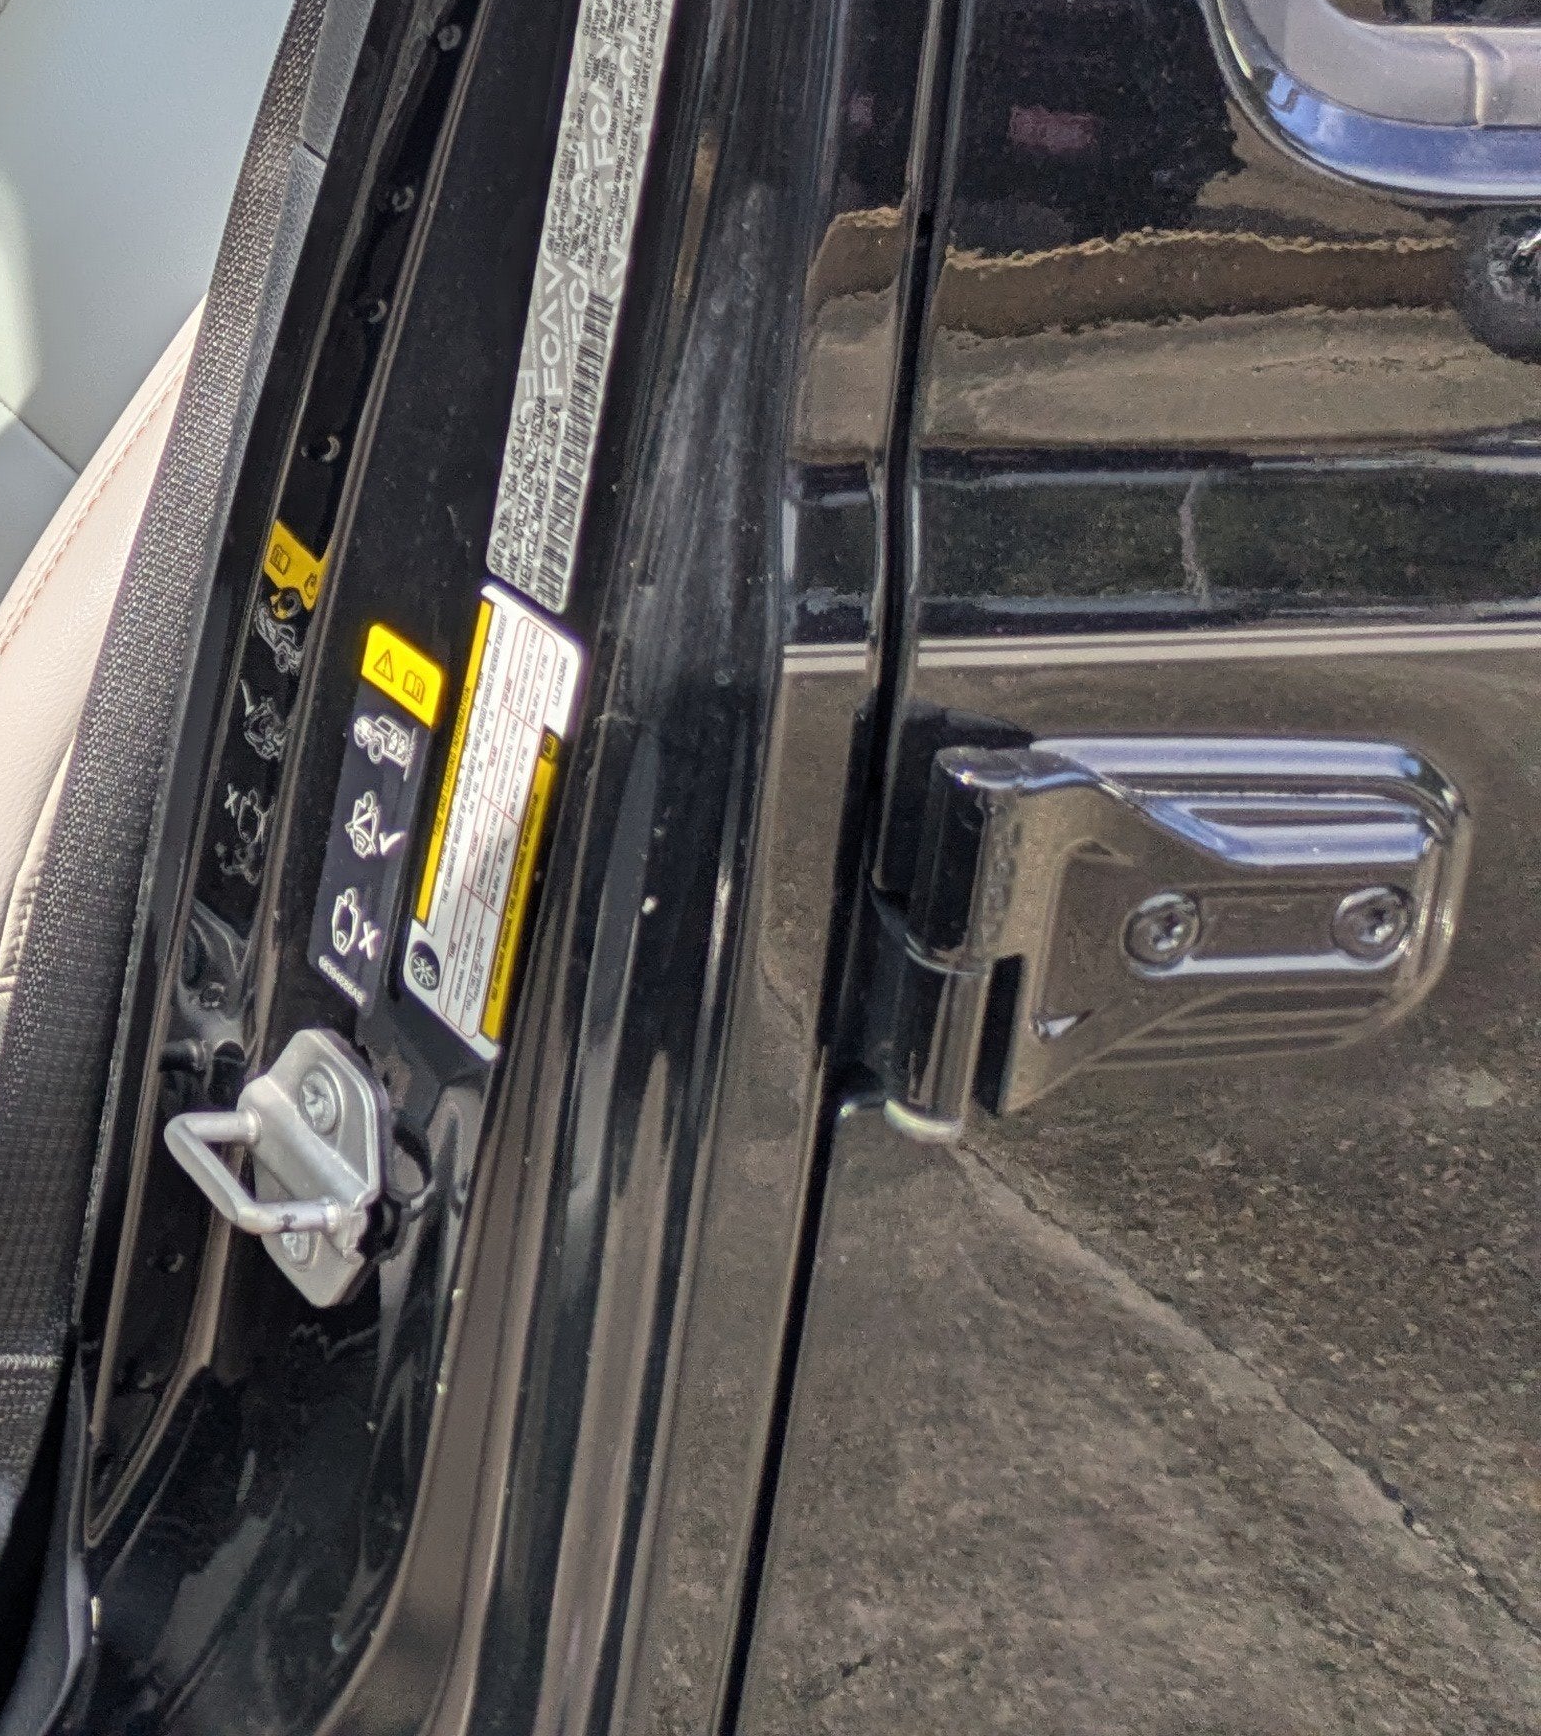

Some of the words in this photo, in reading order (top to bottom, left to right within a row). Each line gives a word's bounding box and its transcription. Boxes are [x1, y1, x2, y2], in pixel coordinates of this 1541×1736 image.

[513, 413, 527, 444] LLC
[509, 444, 522, 468] US
[503, 470, 518, 502] FCA
[518, 525, 540, 591] VEHICLE
[530, 475, 548, 524] MADE
[543, 398, 562, 448] U.S.A.
[491, 535, 507, 574] MFD
[475, 704, 487, 735] CARGO
[481, 671, 494, 706] SHOULD
[488, 644, 499, 673] NEVER
[494, 612, 506, 645] EXCEED
[450, 682, 471, 751] INFORMATION
